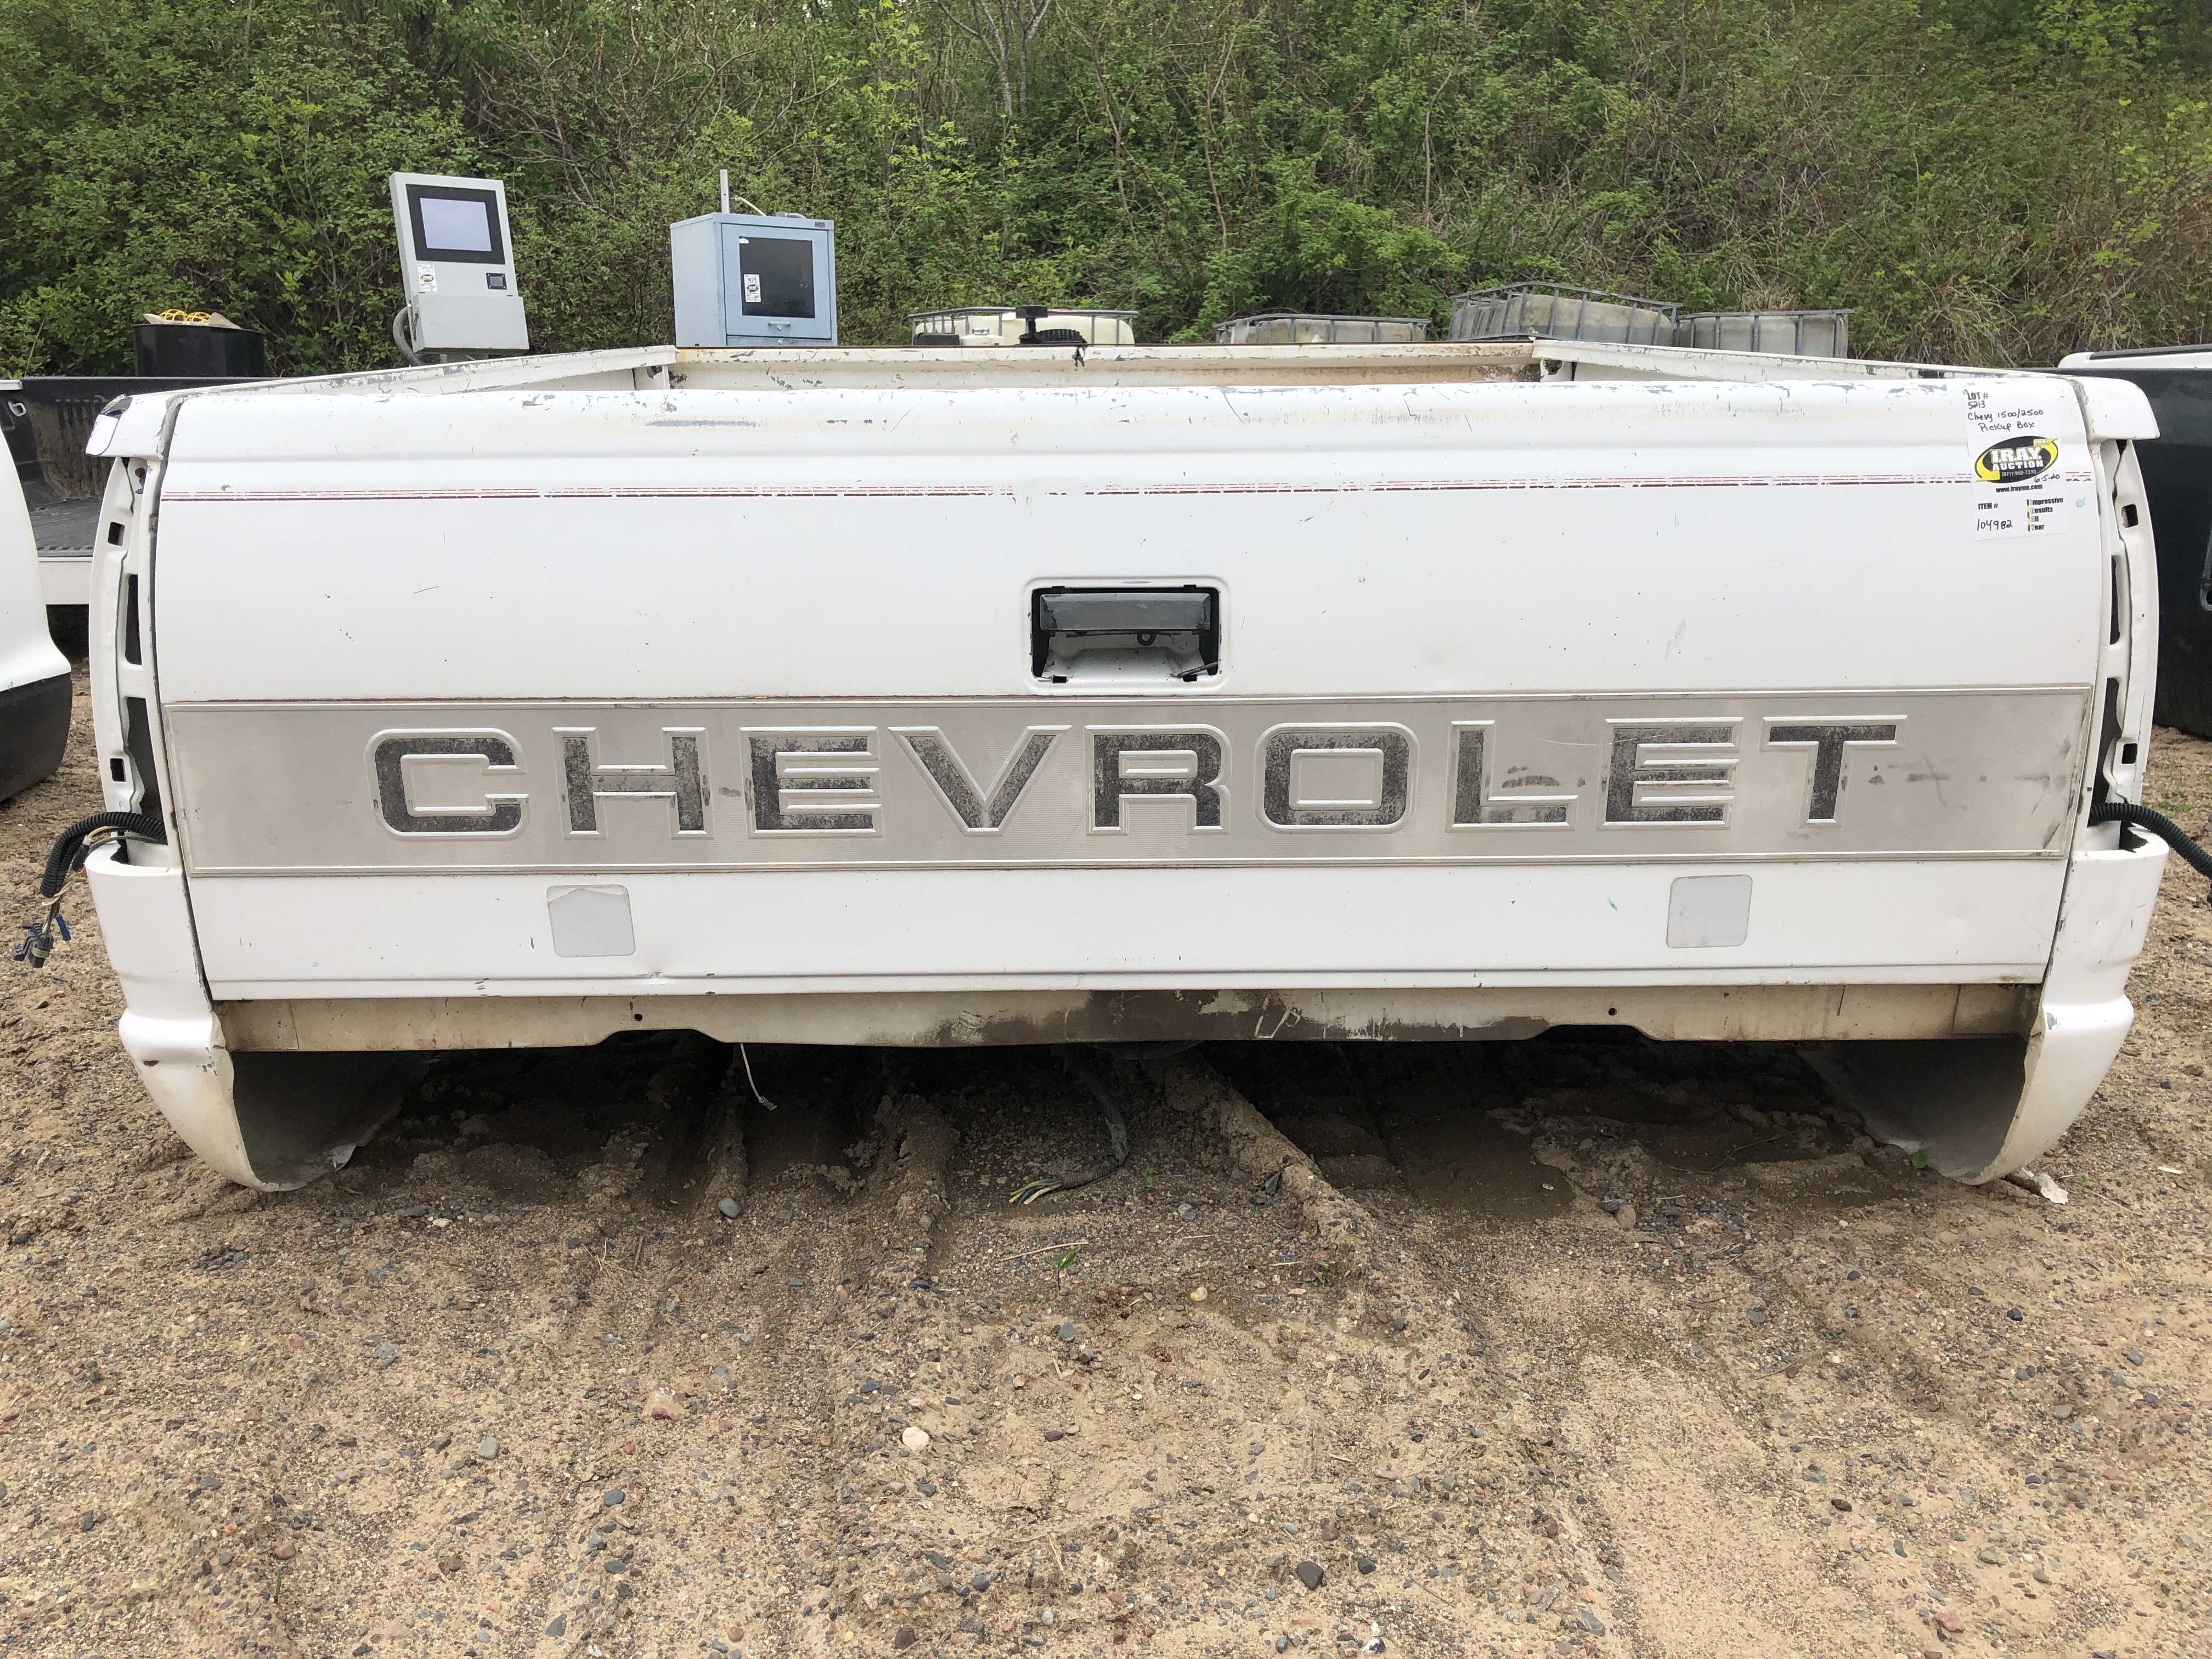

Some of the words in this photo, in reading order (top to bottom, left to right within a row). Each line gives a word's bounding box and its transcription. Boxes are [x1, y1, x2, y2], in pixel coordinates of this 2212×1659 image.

[1967, 392, 1980, 400] LOT
[1968, 400, 1985, 410] 5213
[1967, 411, 1993, 422] Chevy
[1997, 409, 2044, 419] 1500/2500
[2017, 421, 2035, 429] Box
[1993, 460, 2044, 471] AUCTION
[1977, 518, 2013, 532] 104982
[364, 715, 1908, 841] CHEVROLET
